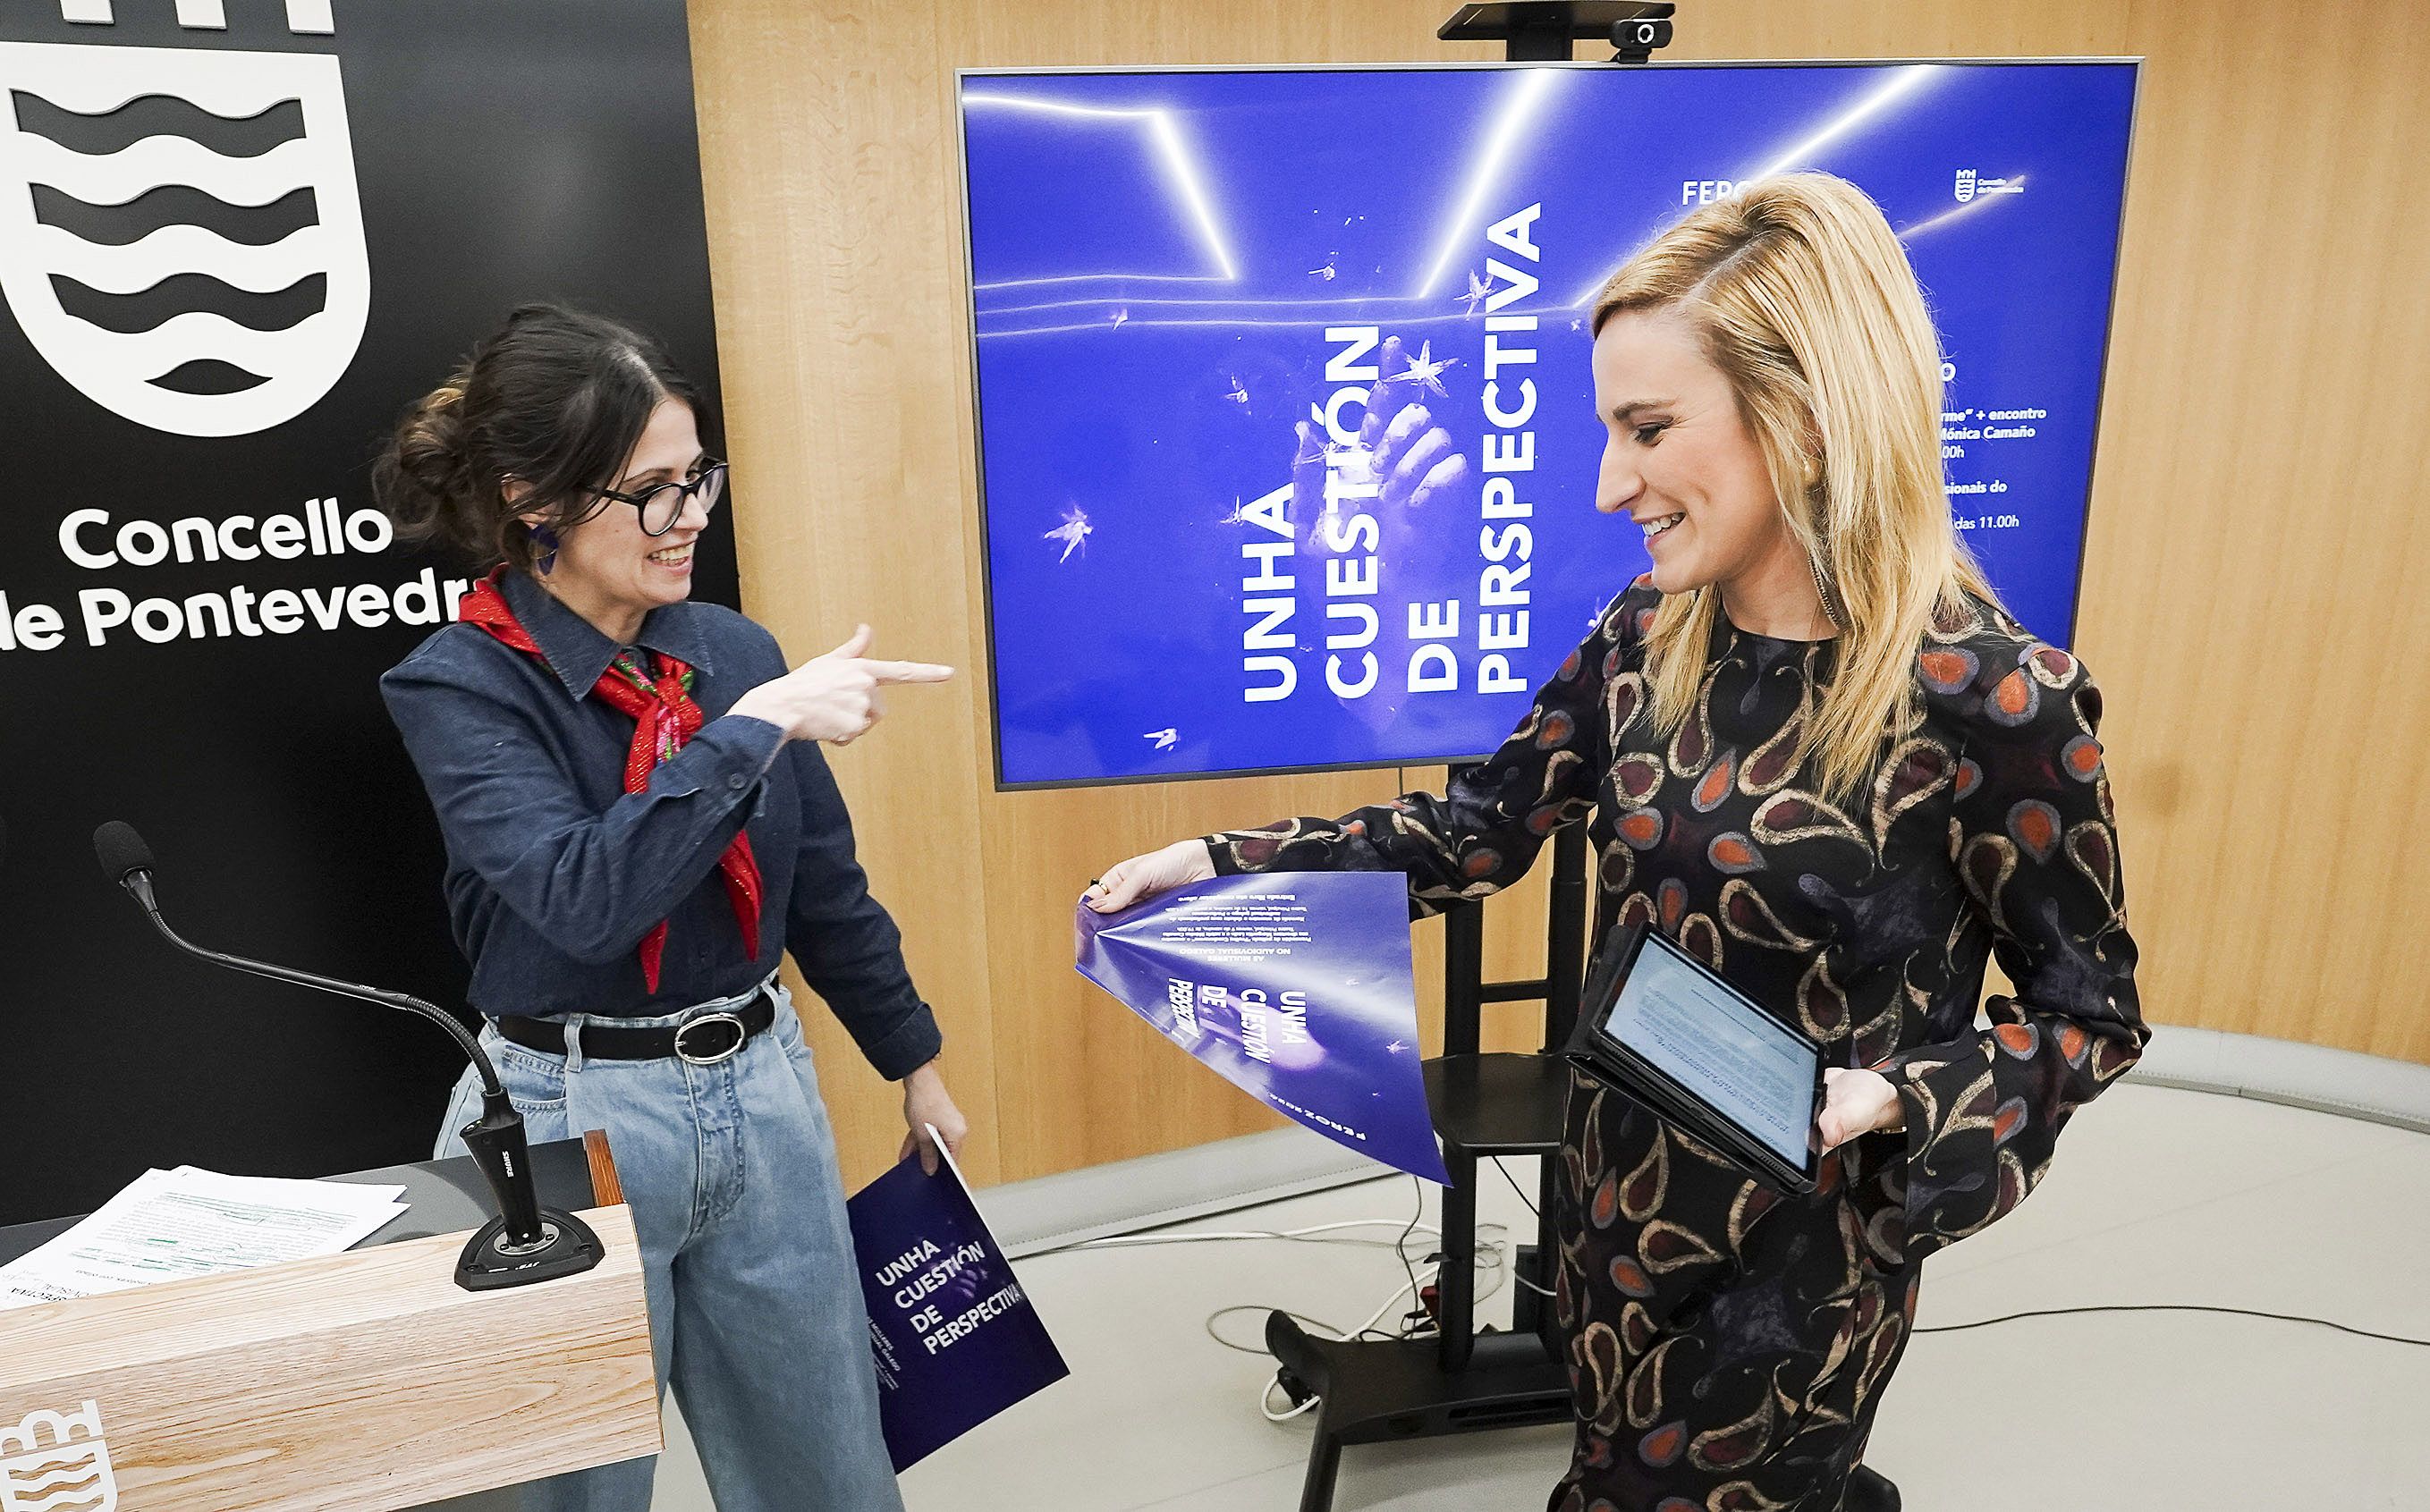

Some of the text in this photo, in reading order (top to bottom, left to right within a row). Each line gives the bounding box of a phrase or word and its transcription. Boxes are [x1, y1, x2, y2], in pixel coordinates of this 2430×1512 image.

[1941, 362, 1957, 382] O
[1984, 426, 2036, 439] Camaño
[1989, 408, 2047, 421] encontro
[1477, 202, 1541, 695] PERSPECTIVA
[1942, 445, 1965, 460] 00h
[1311, 325, 1379, 699] CUESTIÓN
[1944, 479, 2008, 494] sionais do
[58, 497, 394, 569] Concello
[1979, 515, 2019, 529] 11.00h
[78, 567, 476, 647] Pontevedr
[1242, 482, 1298, 702] UNHA
[1407, 598, 1460, 695] DE
[1201, 984, 1228, 1009] DE
[1279, 991, 1307, 1045] UNHA
[1240, 988, 1273, 1064] CUESTIÓN
[503, 1151, 514, 1178] SHURE
[876, 1240, 941, 1288] UNHA
[894, 1241, 986, 1310] CUESTIÓN
[910, 1305, 944, 1334] DE
[923, 1282, 1022, 1356] PERSPECTIVA
